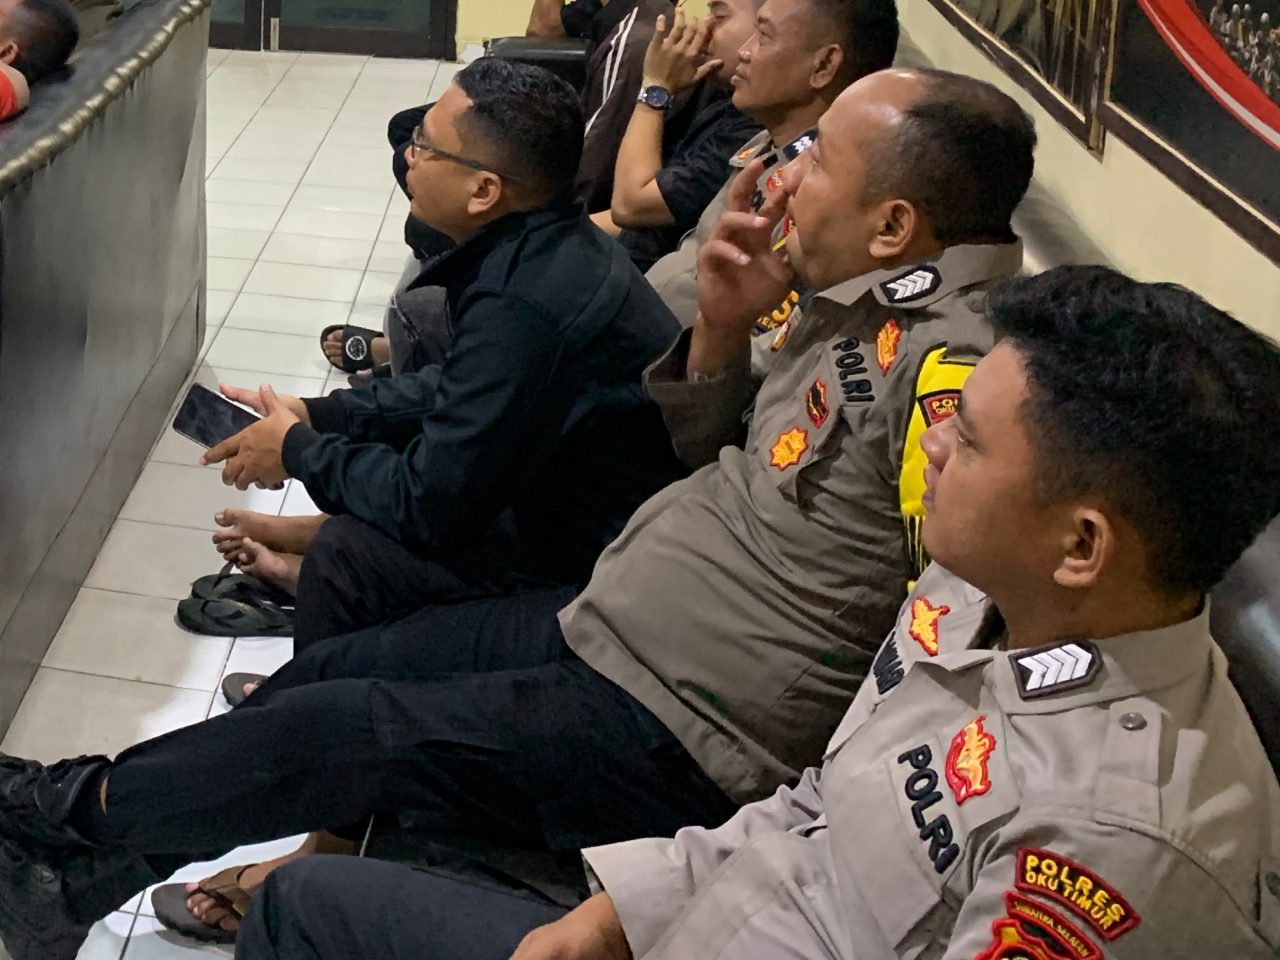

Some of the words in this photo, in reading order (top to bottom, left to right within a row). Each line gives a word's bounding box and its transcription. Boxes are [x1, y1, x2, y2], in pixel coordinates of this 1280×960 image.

[832, 337, 875, 403] POLRI
[935, 405, 955, 415] OKU
[897, 743, 960, 874] POLRI
[1025, 855, 1125, 922] POLRES
[1026, 871, 1059, 890] OKU
[1062, 884, 1114, 930] TIMUR
